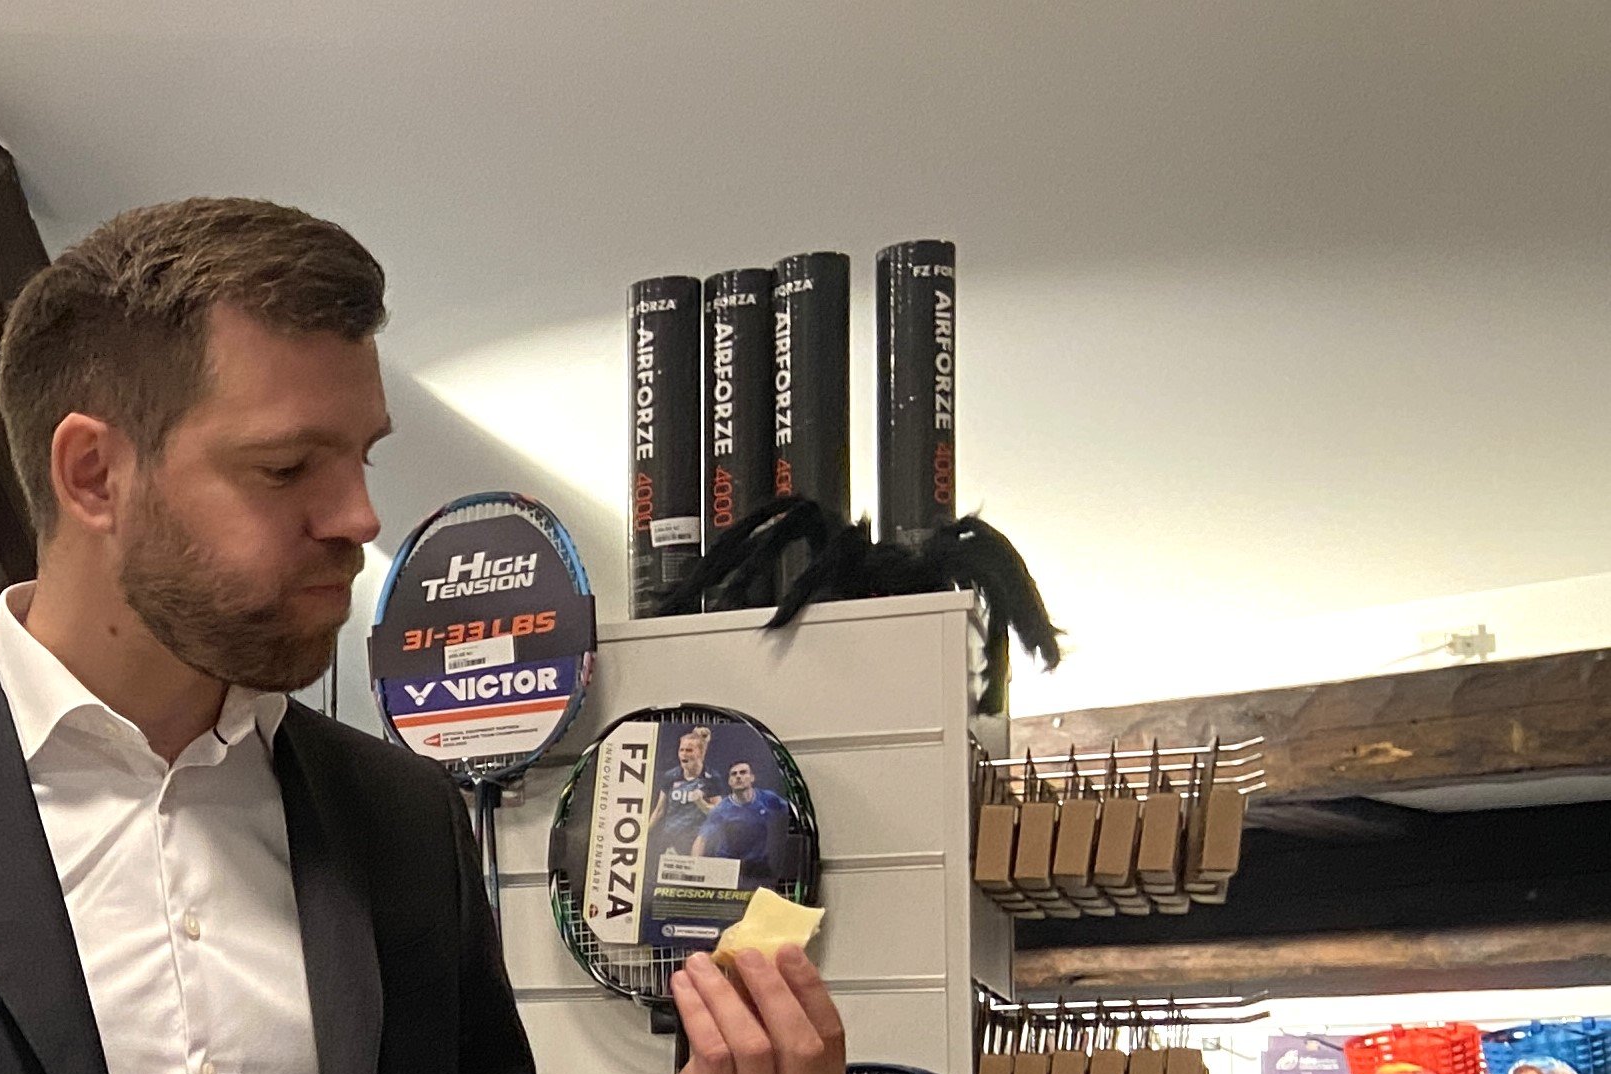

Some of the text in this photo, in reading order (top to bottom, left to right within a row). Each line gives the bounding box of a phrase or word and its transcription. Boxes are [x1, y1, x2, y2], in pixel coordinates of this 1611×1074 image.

[713, 322, 734, 458] AIRFORZE
[774, 311, 793, 448] AIRFORZE
[934, 289, 953, 430] AIRFORZE
[636, 328, 655, 462] AIRFORZE
[713, 463, 733, 529] 4000
[421, 571, 535, 603] TENSION
[447, 551, 538, 584] HIGH
[402, 609, 557, 651] 31-33 LBS
[441, 667, 558, 701] VICTOR
[599, 742, 614, 812] INNOVATED
[592, 834, 605, 893] DENMARK
[605, 743, 649, 919] FZ FORZA
[653, 887, 754, 902] PRECISION SERIE
